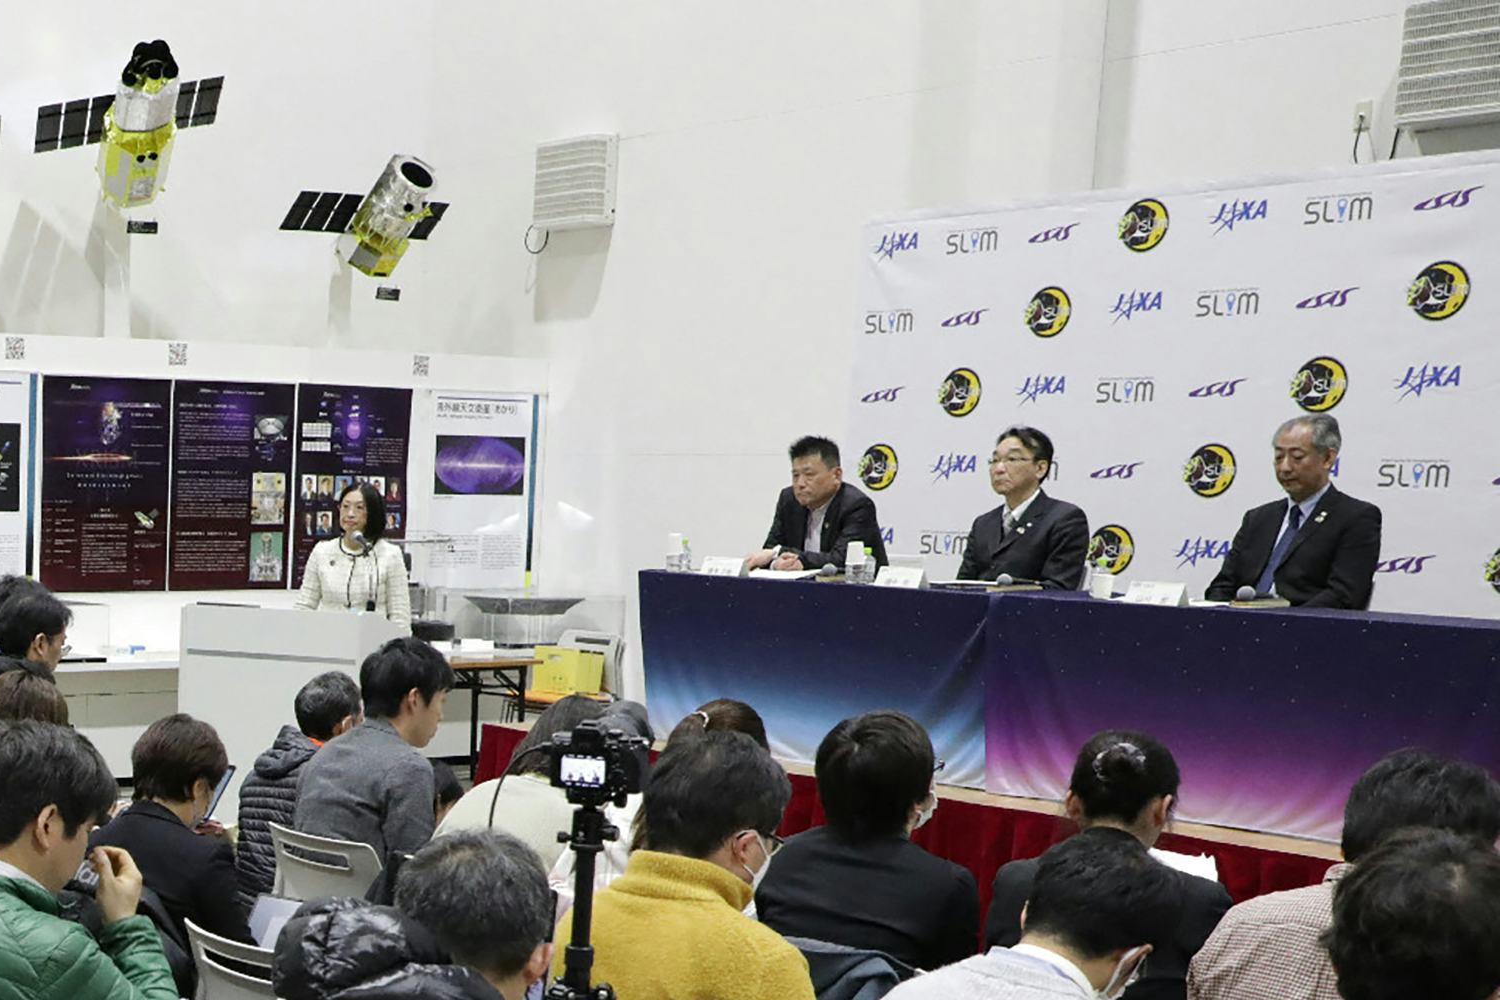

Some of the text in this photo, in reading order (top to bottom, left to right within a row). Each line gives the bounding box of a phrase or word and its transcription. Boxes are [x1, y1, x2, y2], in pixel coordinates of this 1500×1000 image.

[1209, 198, 1268, 236] JAXA
[1303, 197, 1373, 225] SLIM
[873, 231, 919, 262] JAXA
[1109, 289, 1163, 325] JAXA
[1195, 292, 1260, 318] SLIM
[1015, 373, 1066, 407] JAXA
[1393, 361, 1462, 403] JAXA
[930, 452, 977, 483] JAXA
[1377, 463, 1450, 488] SLIM
[1174, 536, 1229, 570] JAXA
